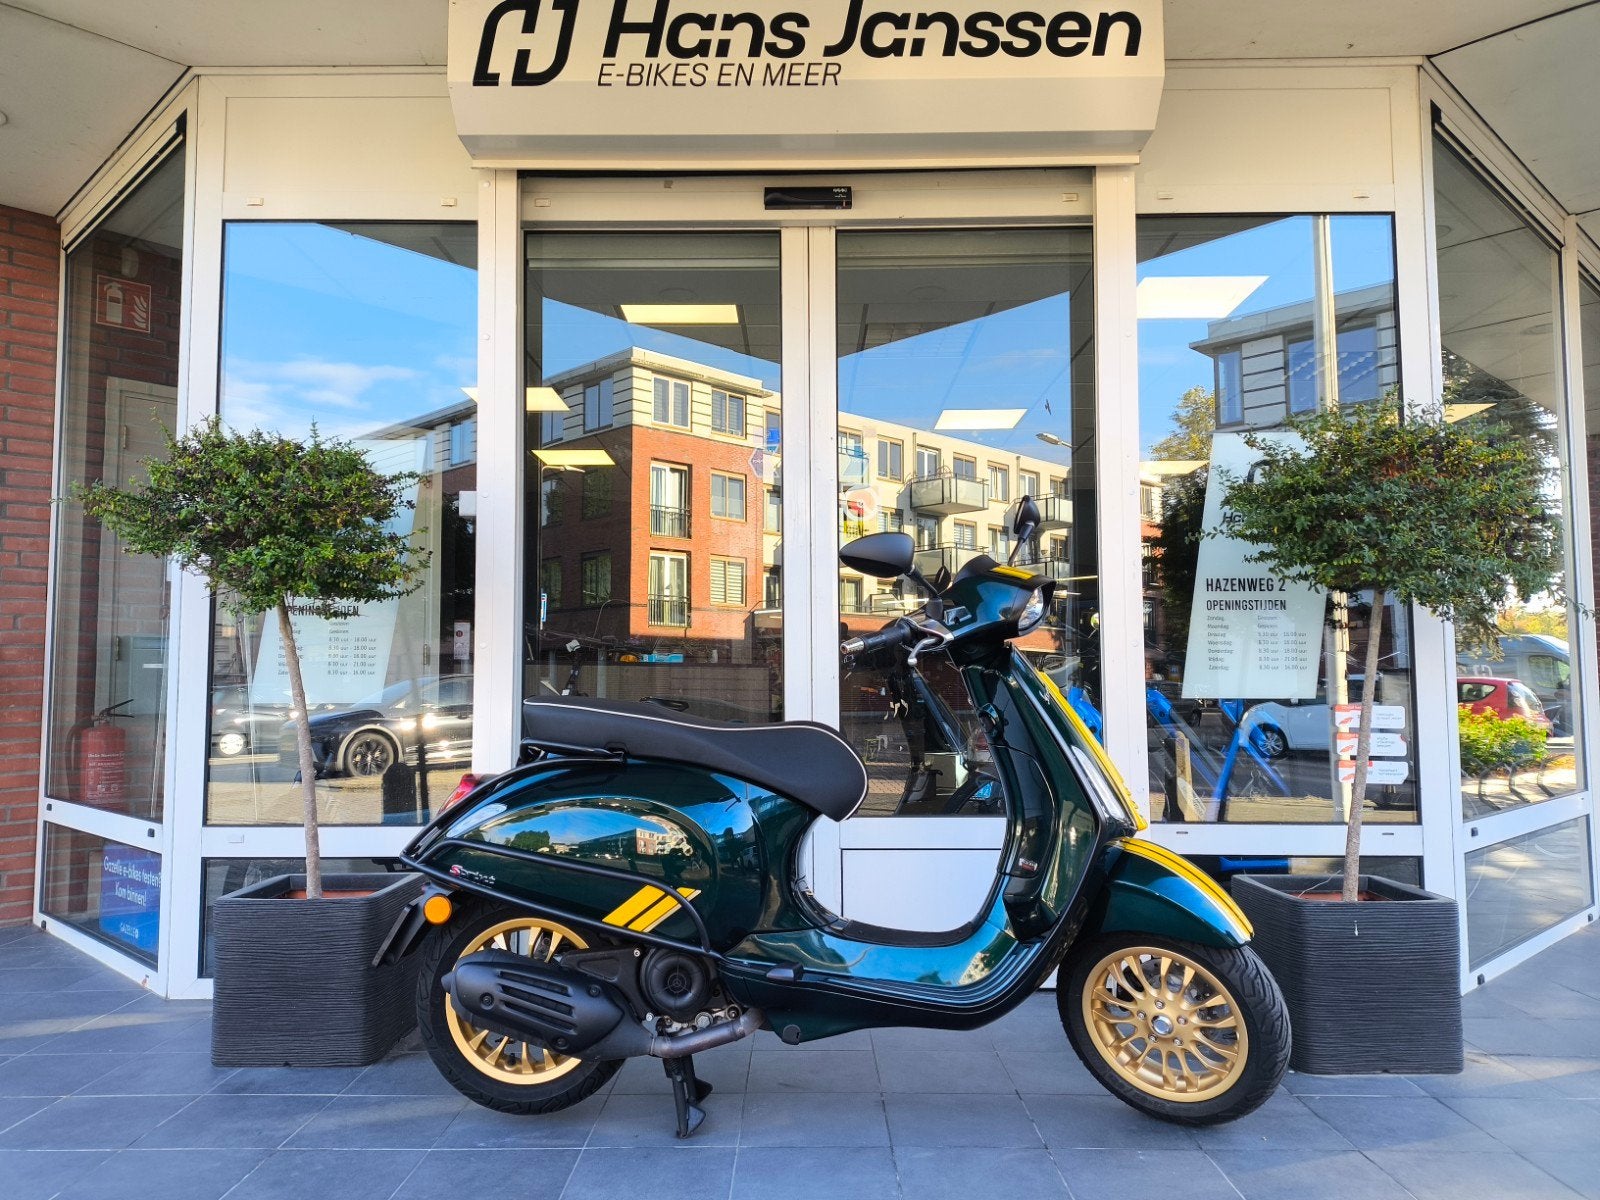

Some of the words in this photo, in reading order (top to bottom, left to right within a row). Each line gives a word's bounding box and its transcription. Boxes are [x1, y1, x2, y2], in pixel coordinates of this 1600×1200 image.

[602, 0, 809, 59] Hans
[823, 0, 1143, 58] Janssen
[597, 62, 709, 87] E-BIKES
[716, 62, 755, 87] EN
[763, 62, 842, 87] MEER
[1206, 577, 1274, 592] HAZENWEG
[1278, 577, 1287, 592] 2
[1206, 599, 1287, 611] OPENINGSTIJDEN
[104, 856, 122, 876] Gazelle
